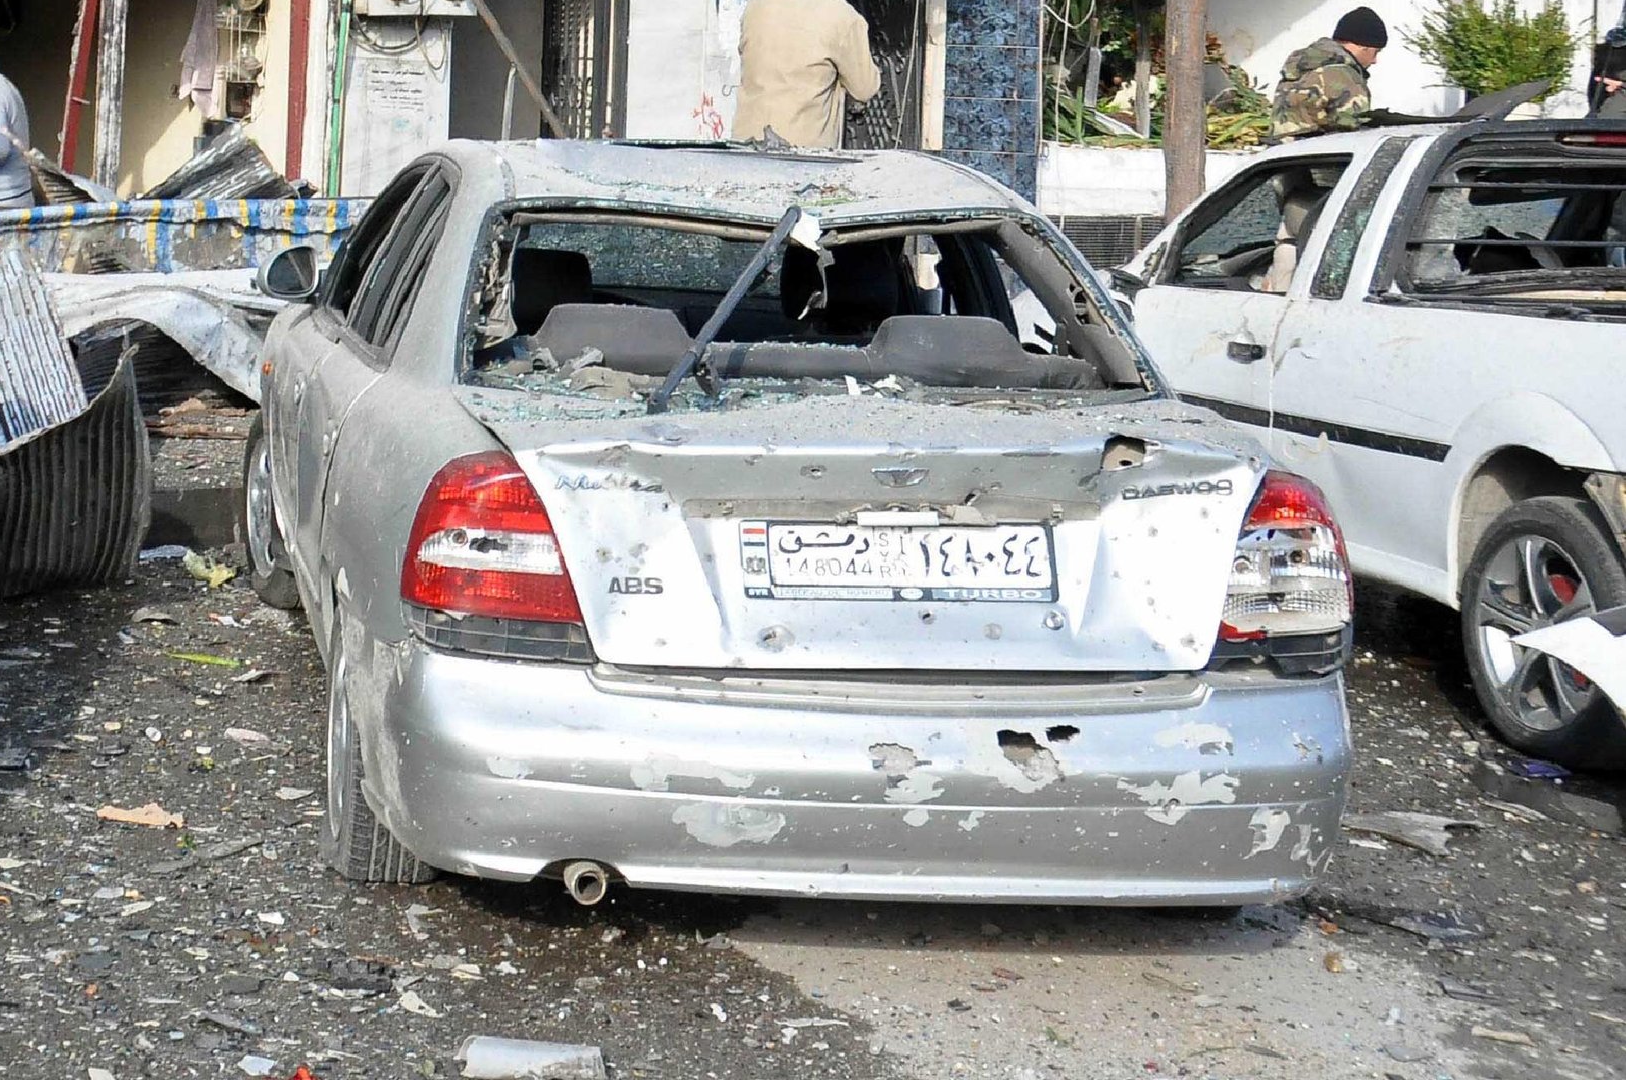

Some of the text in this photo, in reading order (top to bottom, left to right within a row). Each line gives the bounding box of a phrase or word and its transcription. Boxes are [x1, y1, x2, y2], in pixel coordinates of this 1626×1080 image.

[1122, 478, 1234, 501] DAEWOO
[778, 529, 871, 555] دمشق
[608, 576, 664, 595] ABS
[943, 589, 1043, 600] TURBO
